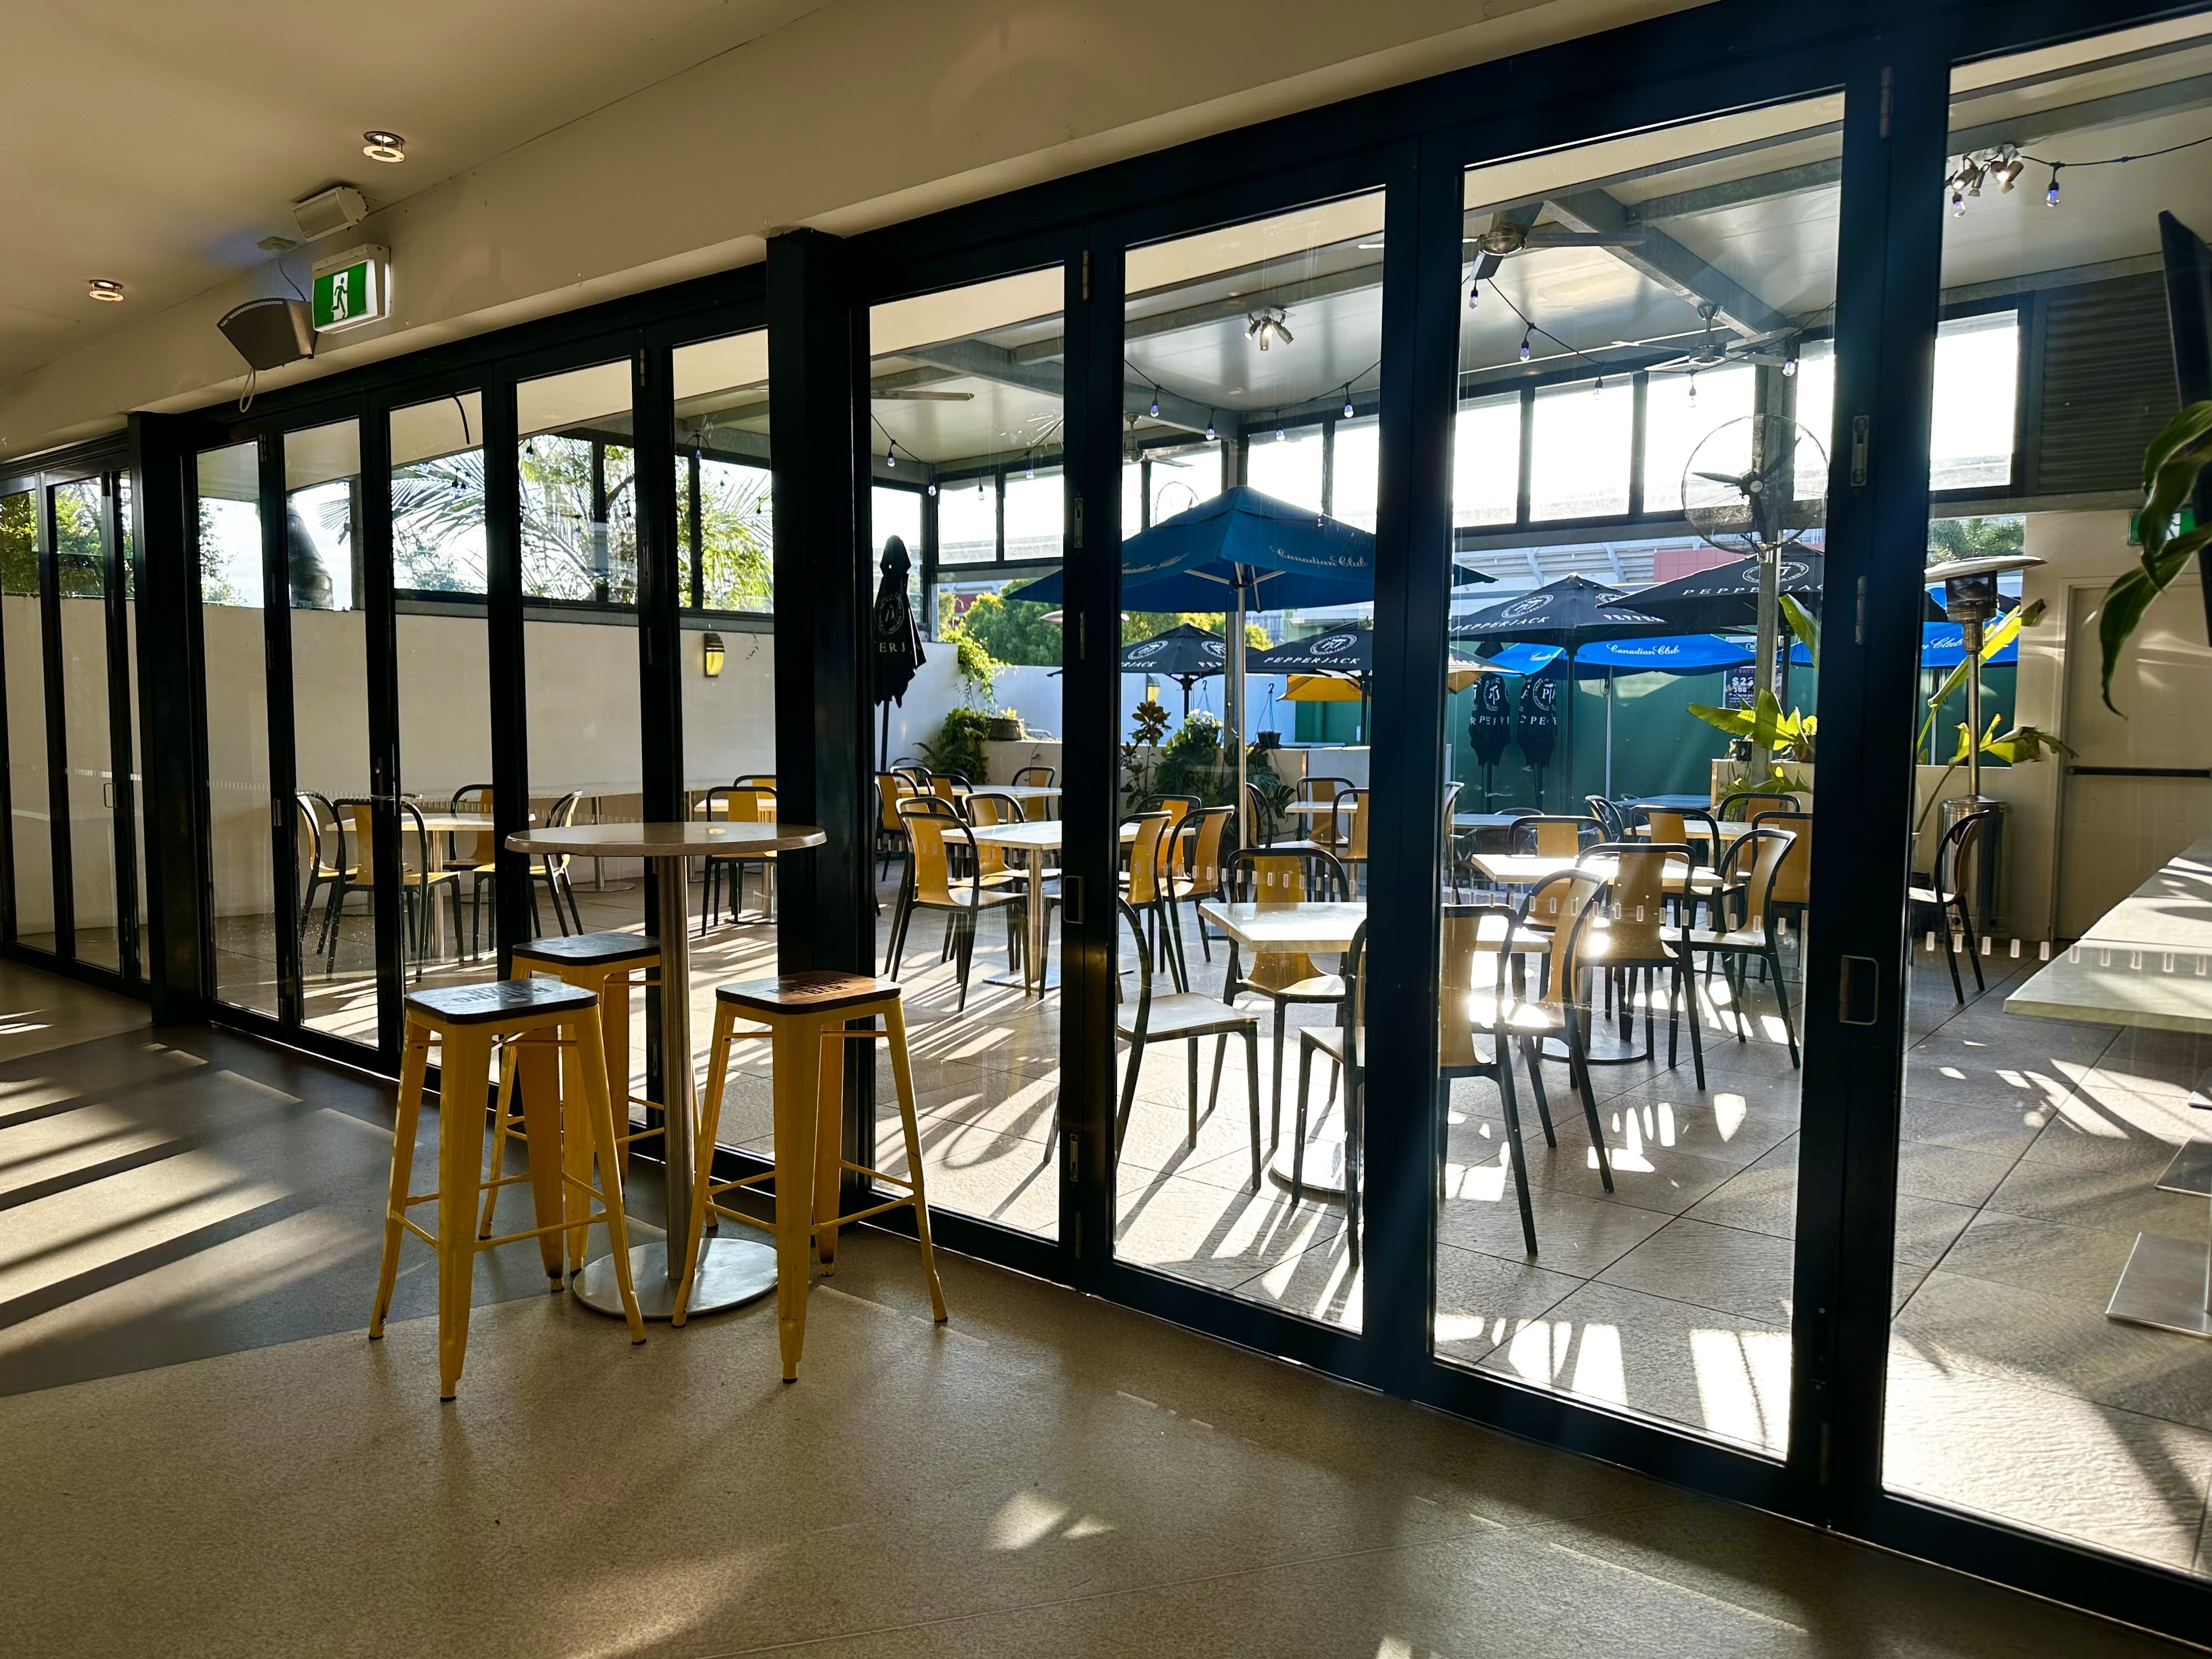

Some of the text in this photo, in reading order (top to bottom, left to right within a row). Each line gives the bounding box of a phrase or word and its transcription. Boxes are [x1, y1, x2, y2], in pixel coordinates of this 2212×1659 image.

[1269, 545, 1369, 567] Canadian Club
[1451, 616, 1550, 631] PEPPERJACK
[1606, 643, 1680, 655] Canadian Club
